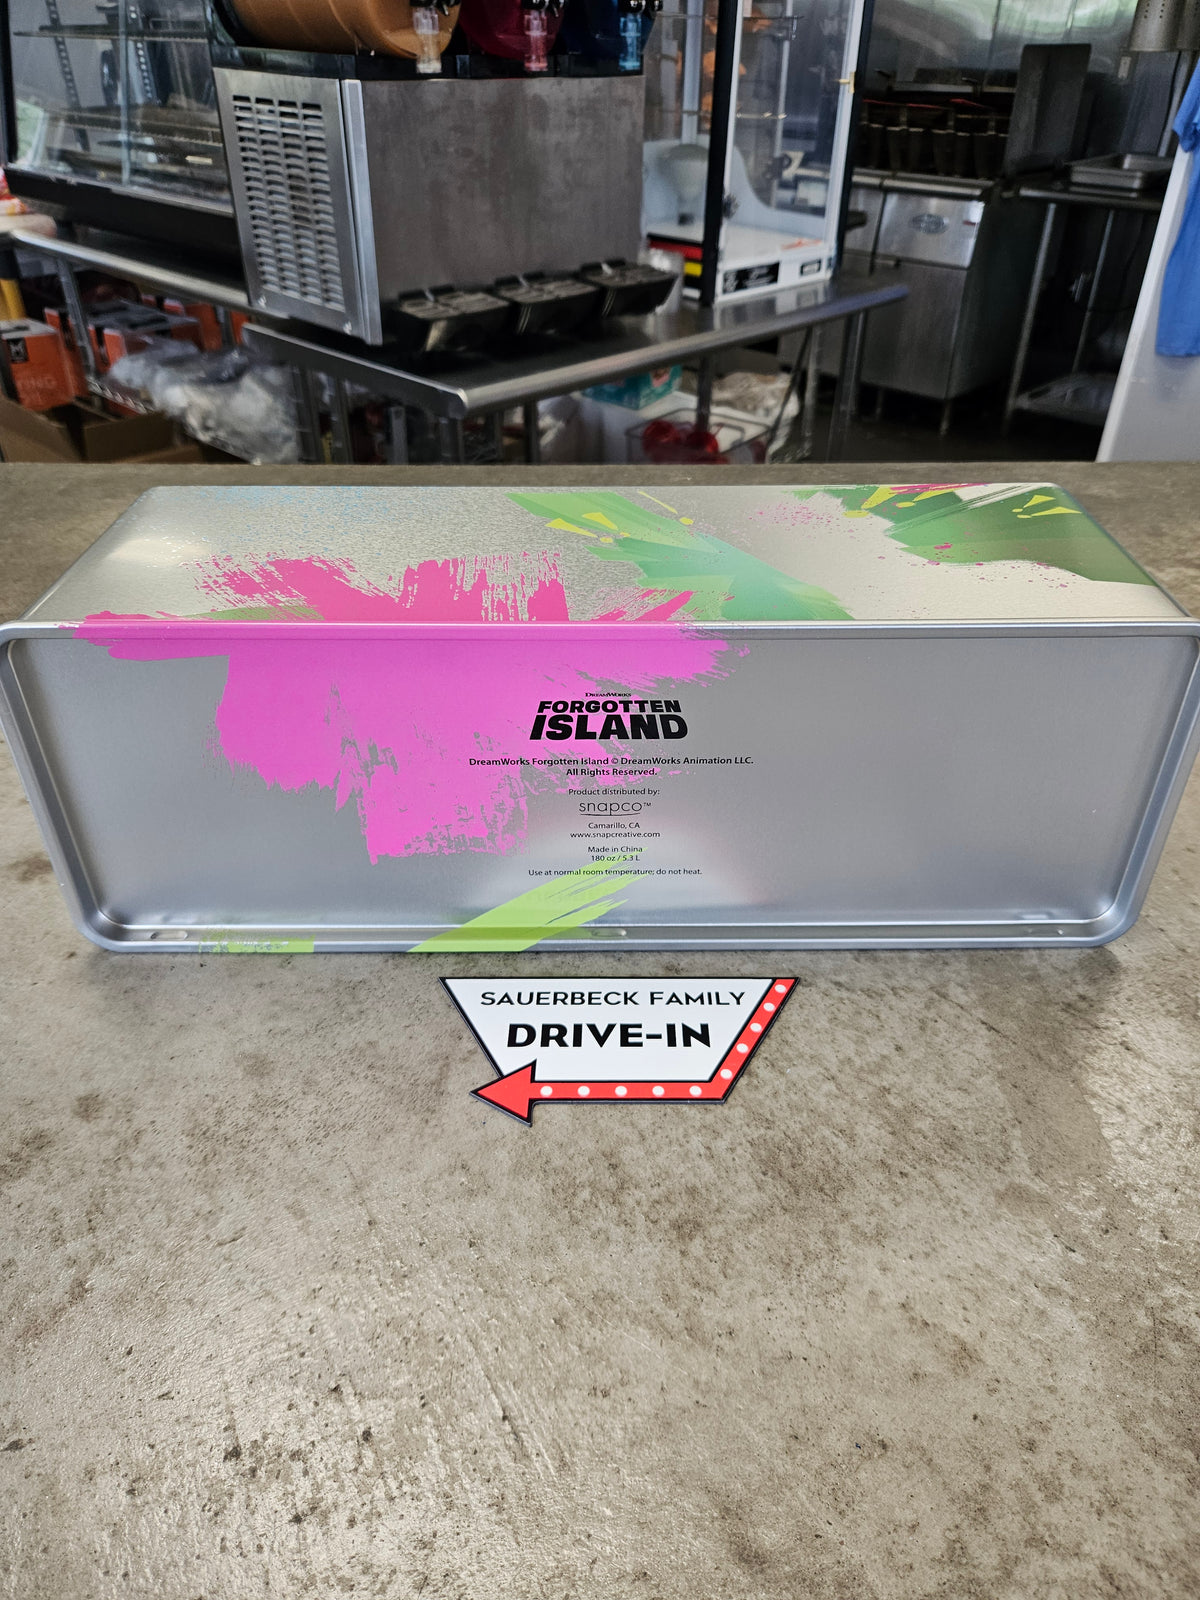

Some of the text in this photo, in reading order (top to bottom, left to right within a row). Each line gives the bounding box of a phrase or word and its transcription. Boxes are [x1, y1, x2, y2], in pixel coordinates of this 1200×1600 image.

[537, 699, 682, 714] FORGOTTEN
[529, 713, 689, 740] ISLAND
[469, 758, 530, 766] DreamWorks
[532, 758, 579, 767] Forgotten
[581, 757, 609, 765] Island
[620, 757, 681, 765] DreamWorks
[683, 757, 732, 765] Animation
[734, 756, 754, 765] LLC.
[566, 768, 658, 778] All Rights Reserved.
[568, 788, 661, 797] Product distributed by:
[588, 822, 627, 830] Camarillo,
[570, 831, 661, 839] www.snapcreative.com
[481, 991, 746, 1006] SAUERBECK FAMILY
[507, 1023, 711, 1048] DRIVE-IN
